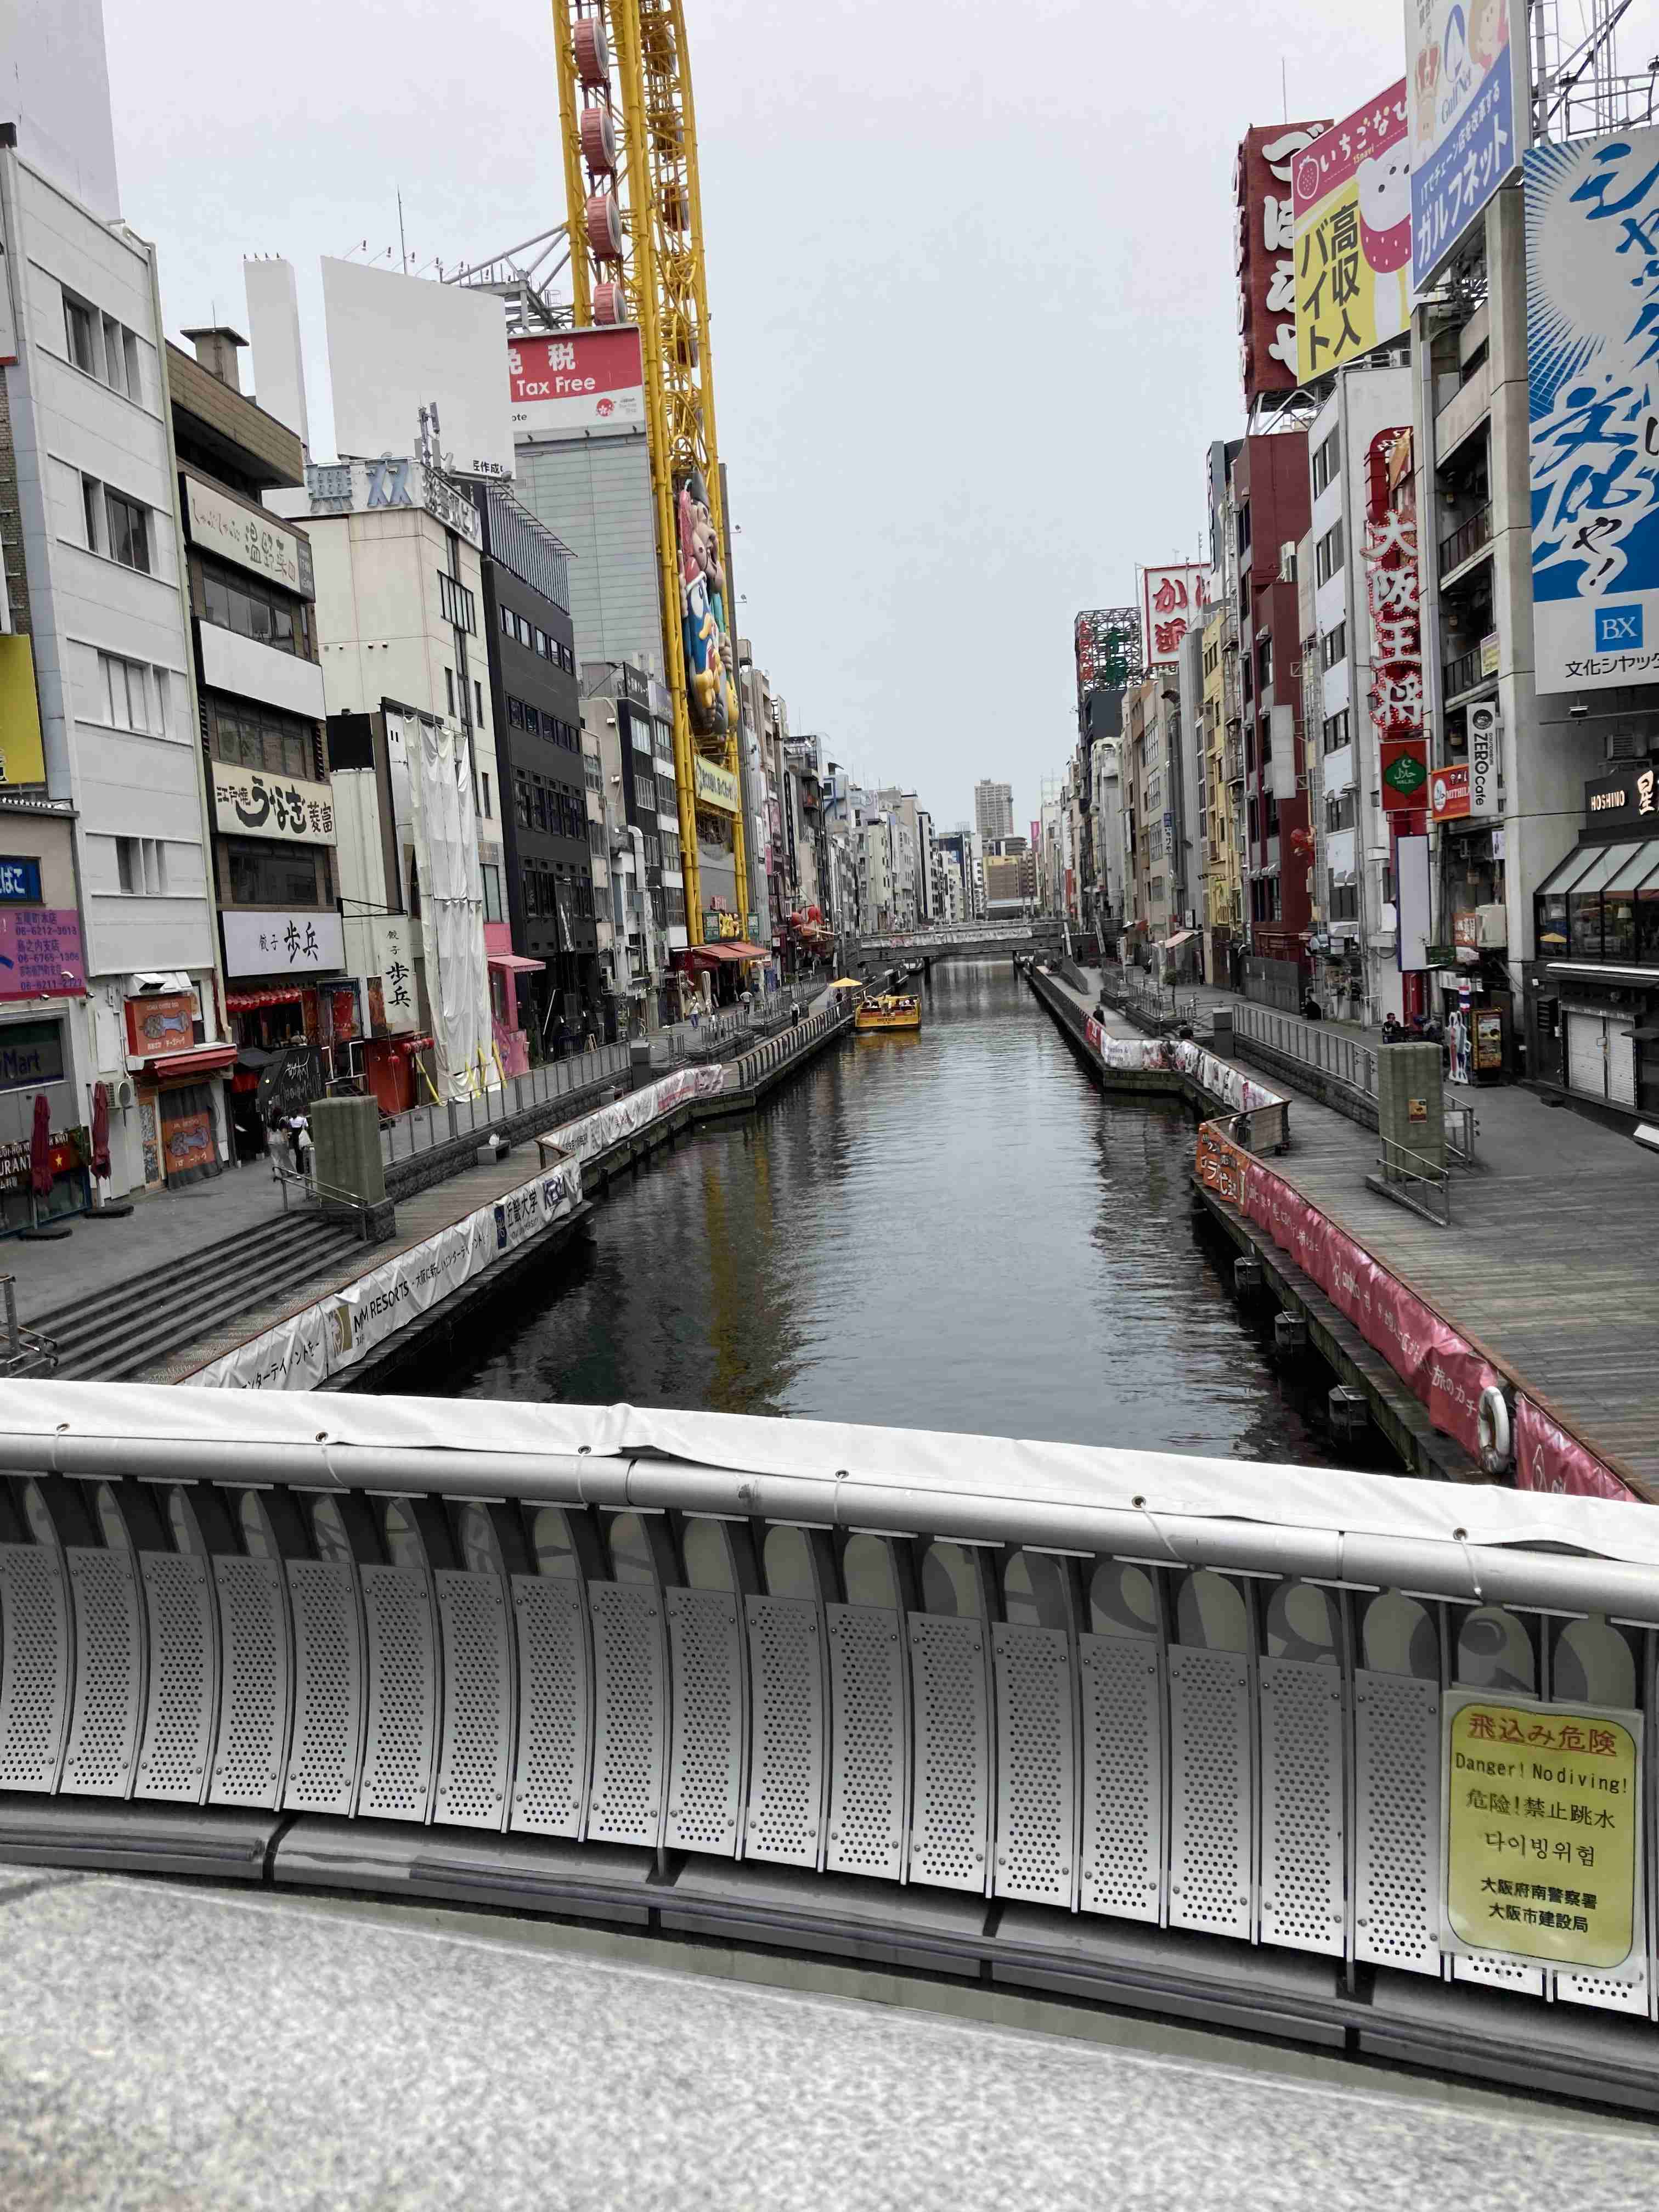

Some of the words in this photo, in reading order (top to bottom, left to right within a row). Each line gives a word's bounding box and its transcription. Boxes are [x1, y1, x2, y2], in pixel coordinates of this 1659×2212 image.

[1418, 113, 1508, 270] ガルフネット
[1300, 217, 1330, 371] バイト
[1329, 199, 1362, 358] 高収入
[517, 380, 550, 396] Tax
[555, 376, 596, 393] Free
[1364, 511, 1424, 725] 大阪王将
[1602, 616, 1638, 640] BX
[1591, 791, 1625, 811] HOSHINO
[369, 1281, 410, 1319] RESORTS
[1469, 1713, 1618, 1754] 飛込み危険
[1455, 1752, 1525, 1776] Danger!
[1481, 1876, 1598, 1910] 大阪府南警察署
[1488, 1902, 1589, 1933] 大阪市建設局
